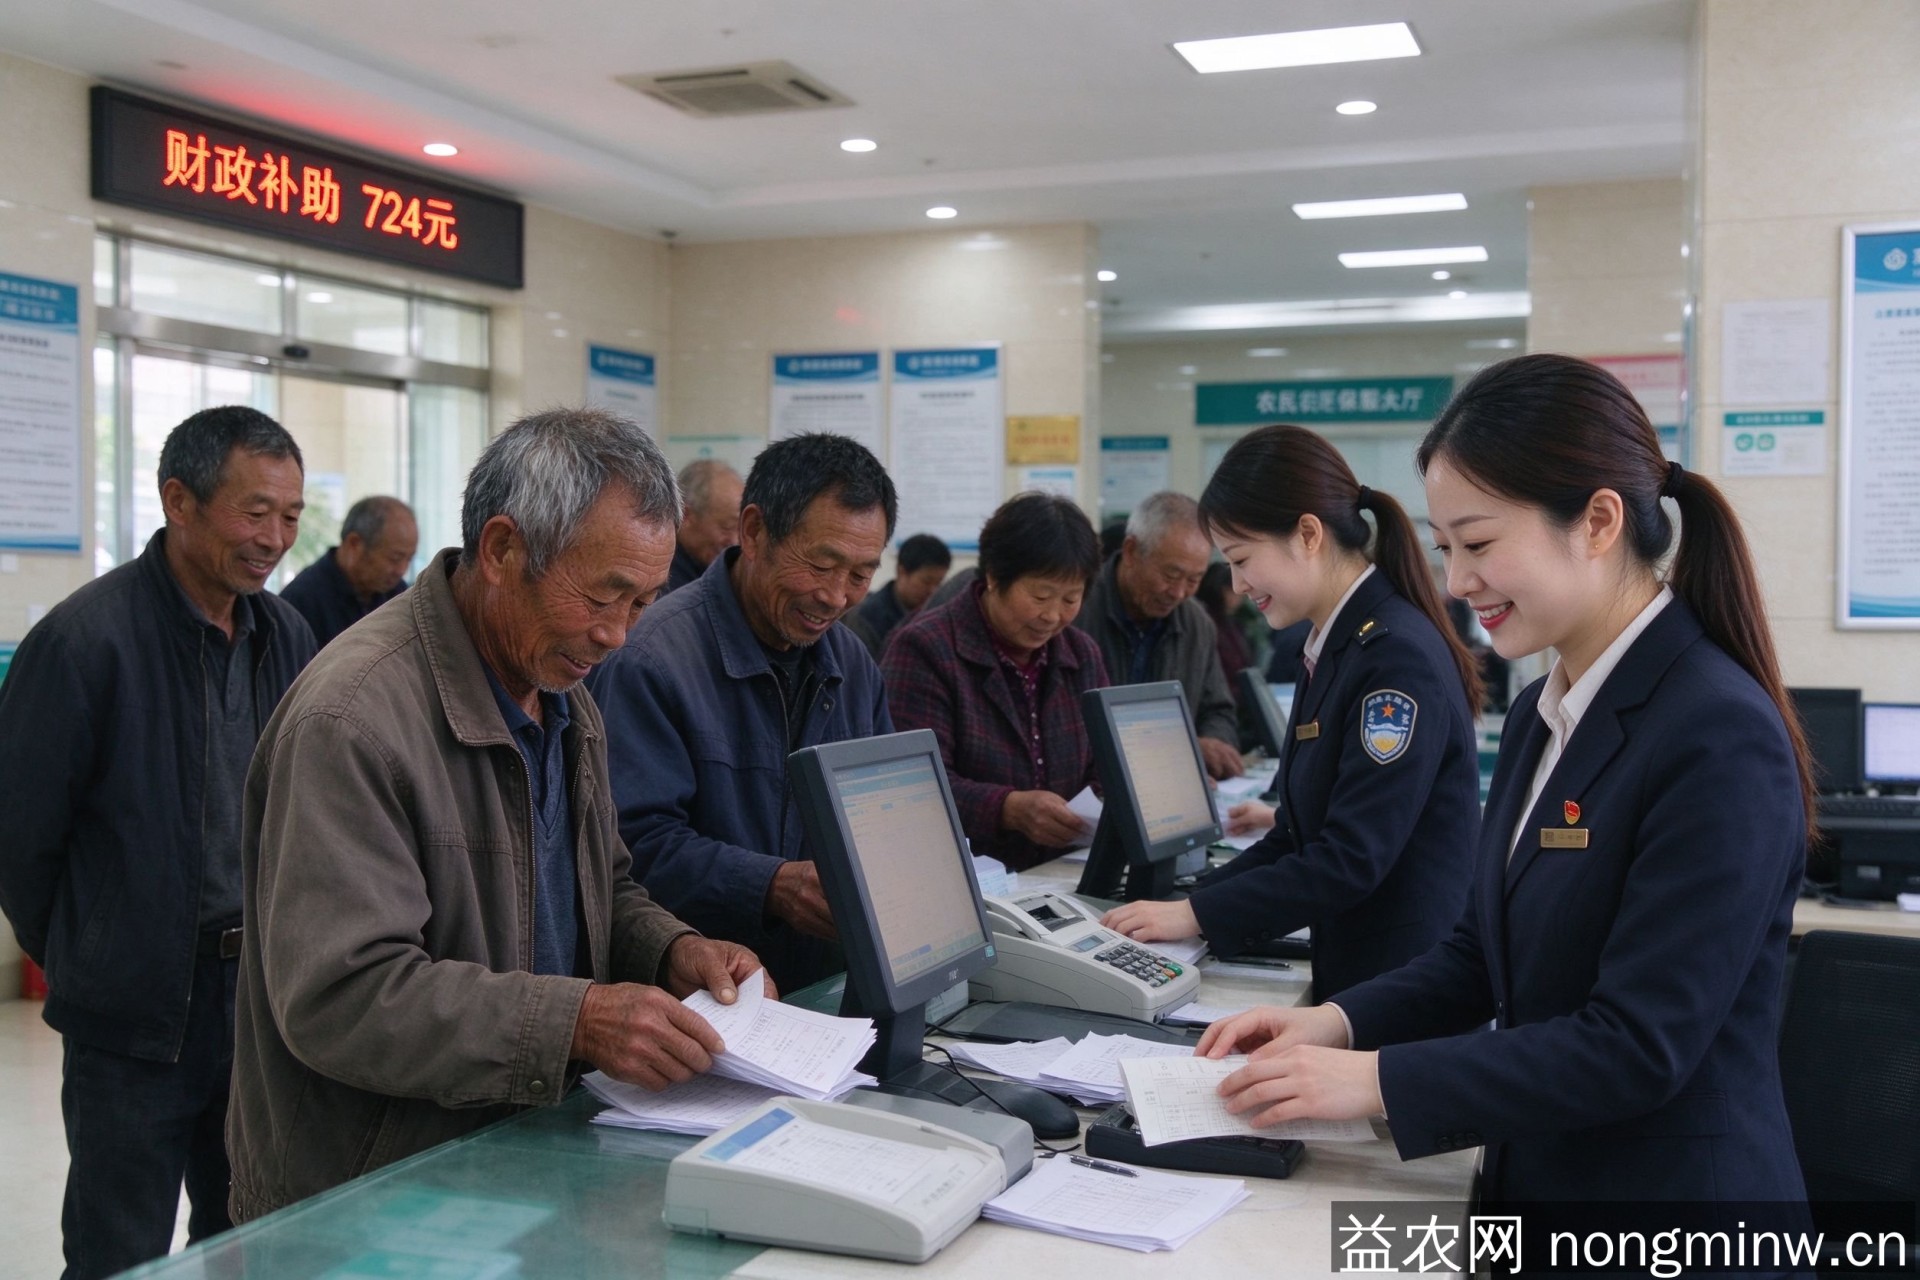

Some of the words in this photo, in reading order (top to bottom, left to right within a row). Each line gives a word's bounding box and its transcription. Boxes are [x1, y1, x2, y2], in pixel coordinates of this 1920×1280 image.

[163, 129, 341, 224] 财政补助
[361, 184, 458, 250] 724元
